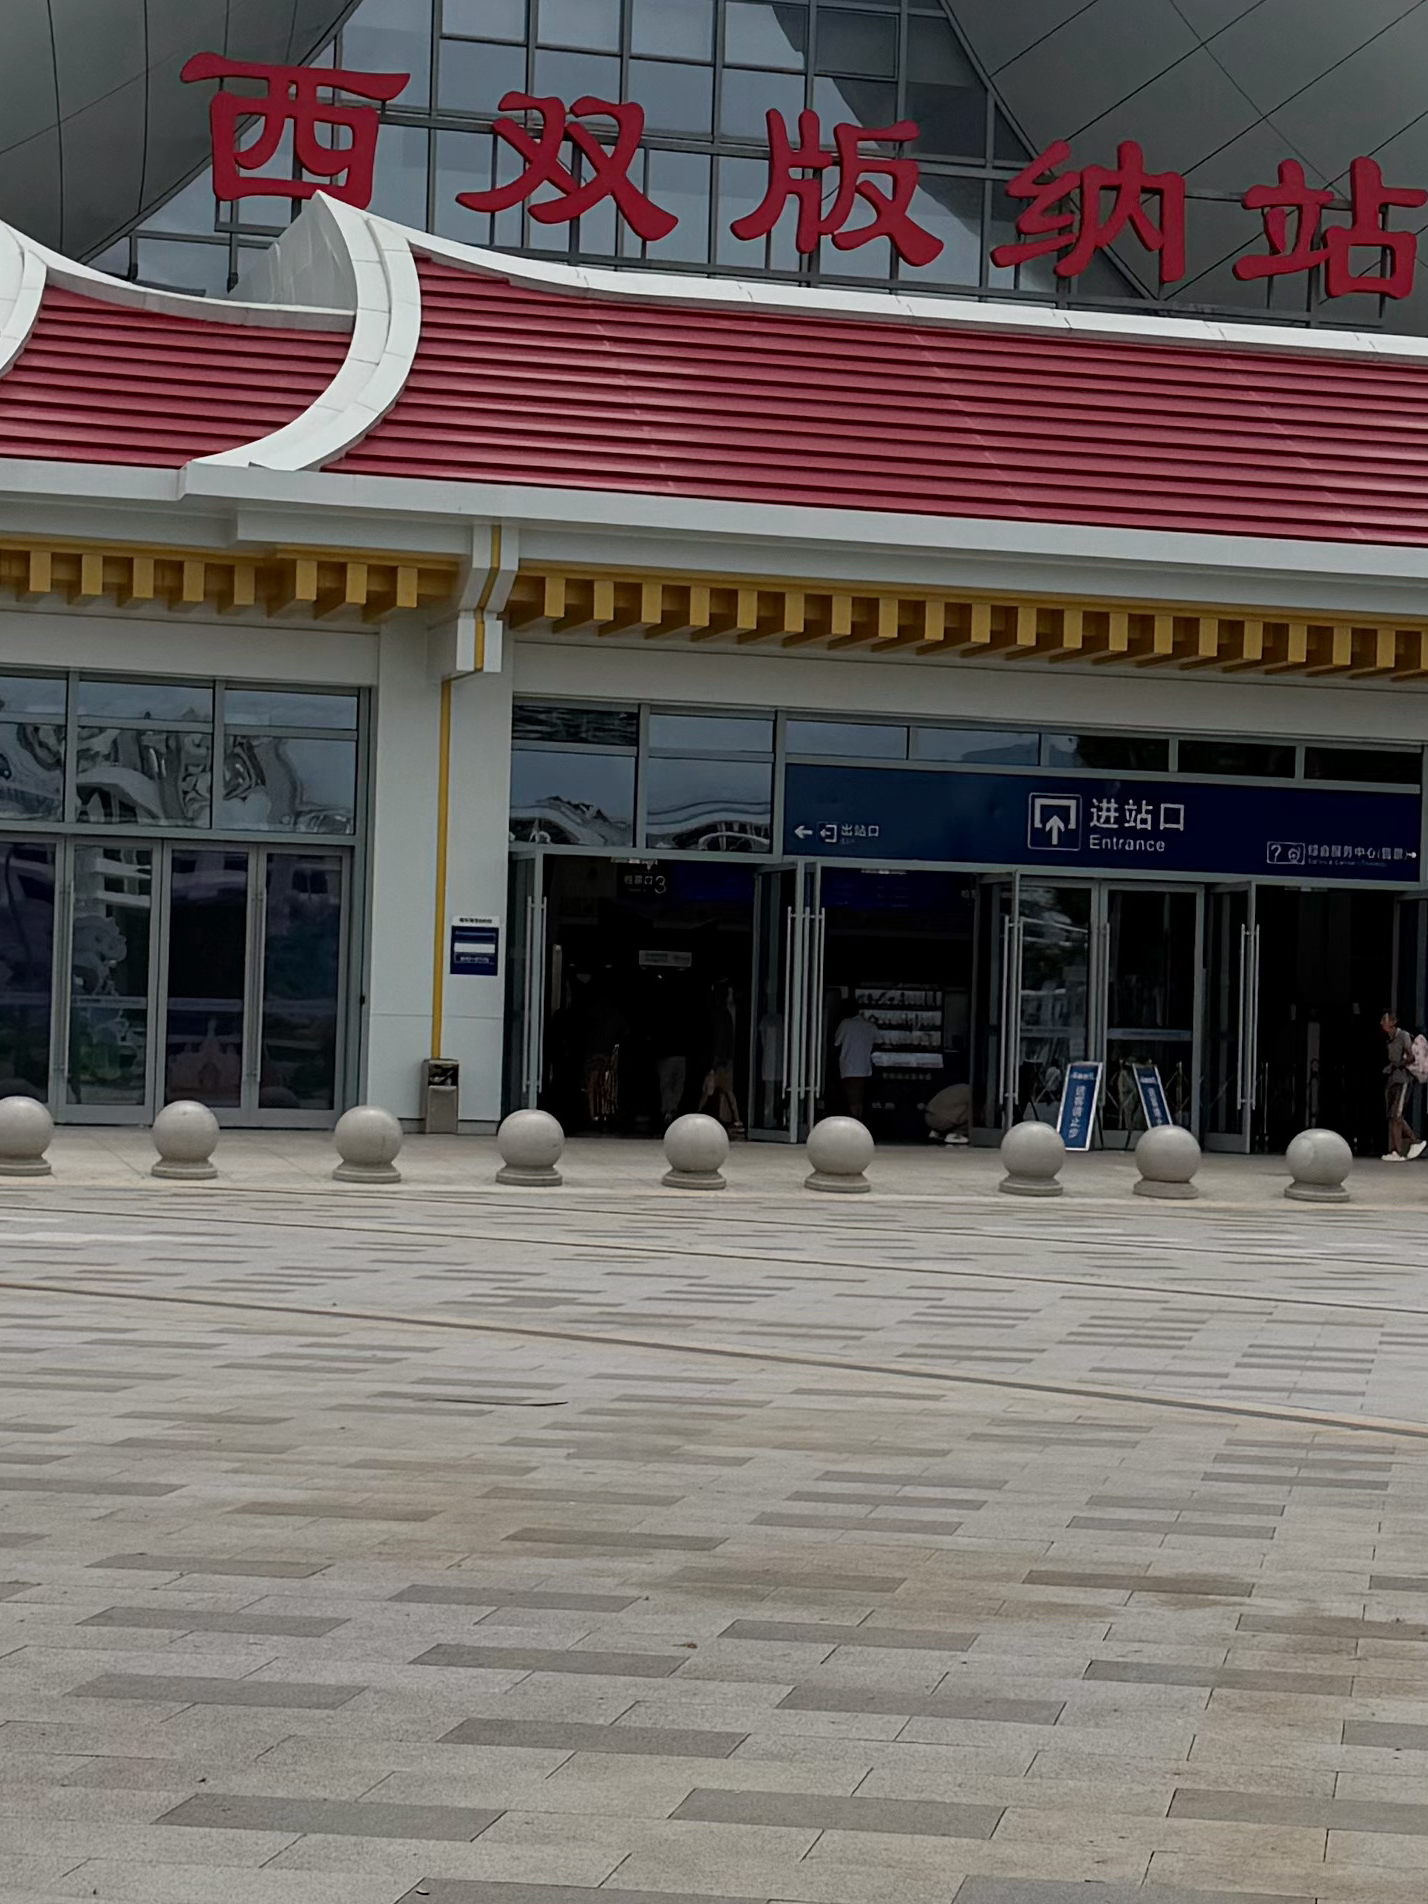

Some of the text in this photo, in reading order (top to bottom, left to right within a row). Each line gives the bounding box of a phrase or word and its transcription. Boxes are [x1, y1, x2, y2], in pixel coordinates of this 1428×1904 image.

[180, 50, 1428, 301] 西双版纳站
[1089, 798, 1185, 831] 进站口
[840, 823, 880, 837] 出站口
[1089, 834, 1166, 852] Entrance
[655, 875, 667, 894] 3
